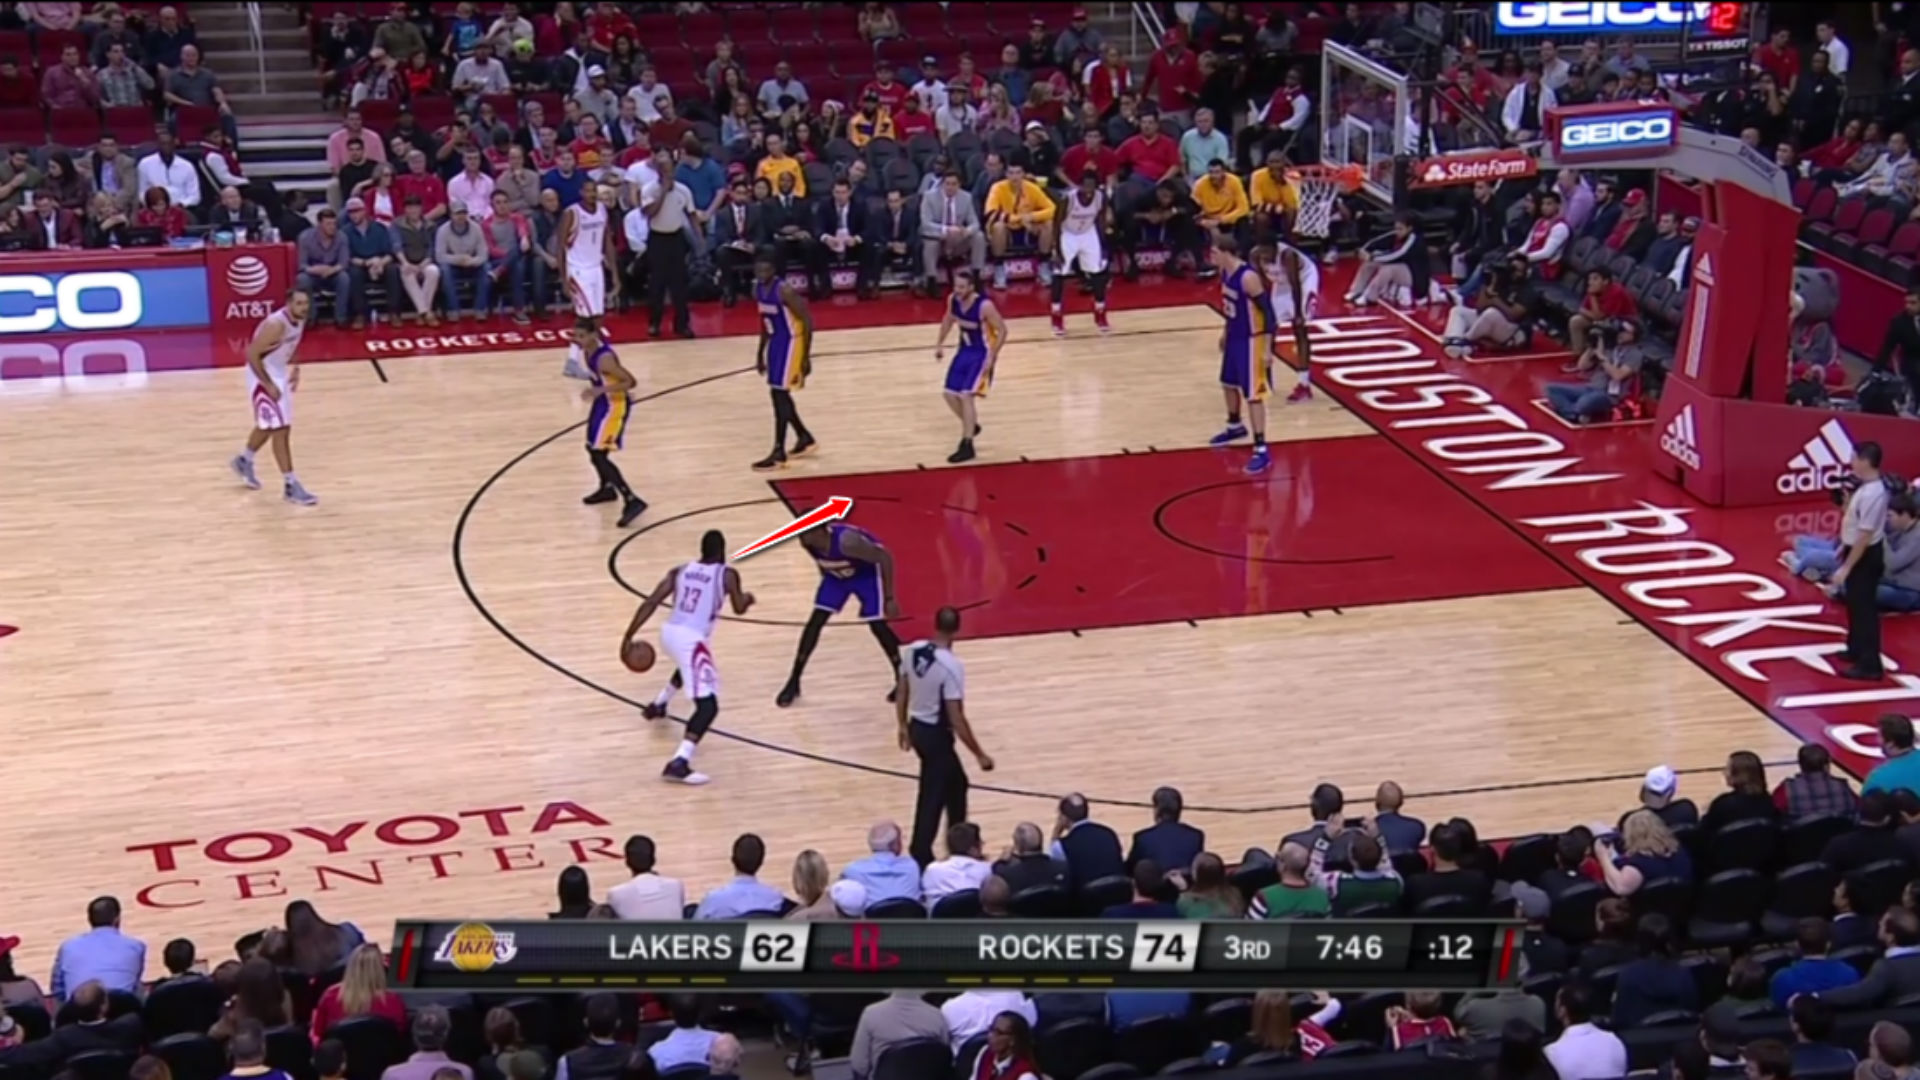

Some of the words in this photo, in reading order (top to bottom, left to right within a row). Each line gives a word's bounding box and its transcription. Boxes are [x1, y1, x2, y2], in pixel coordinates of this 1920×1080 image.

[1562, 117, 1672, 147] GEICO
[226, 300, 274, 319] AT&T
[1275, 315, 1625, 490] HOUSTON
[680, 585, 702, 613] 13
[125, 800, 612, 872] TOYOTA
[134, 836, 626, 909] CENTER
